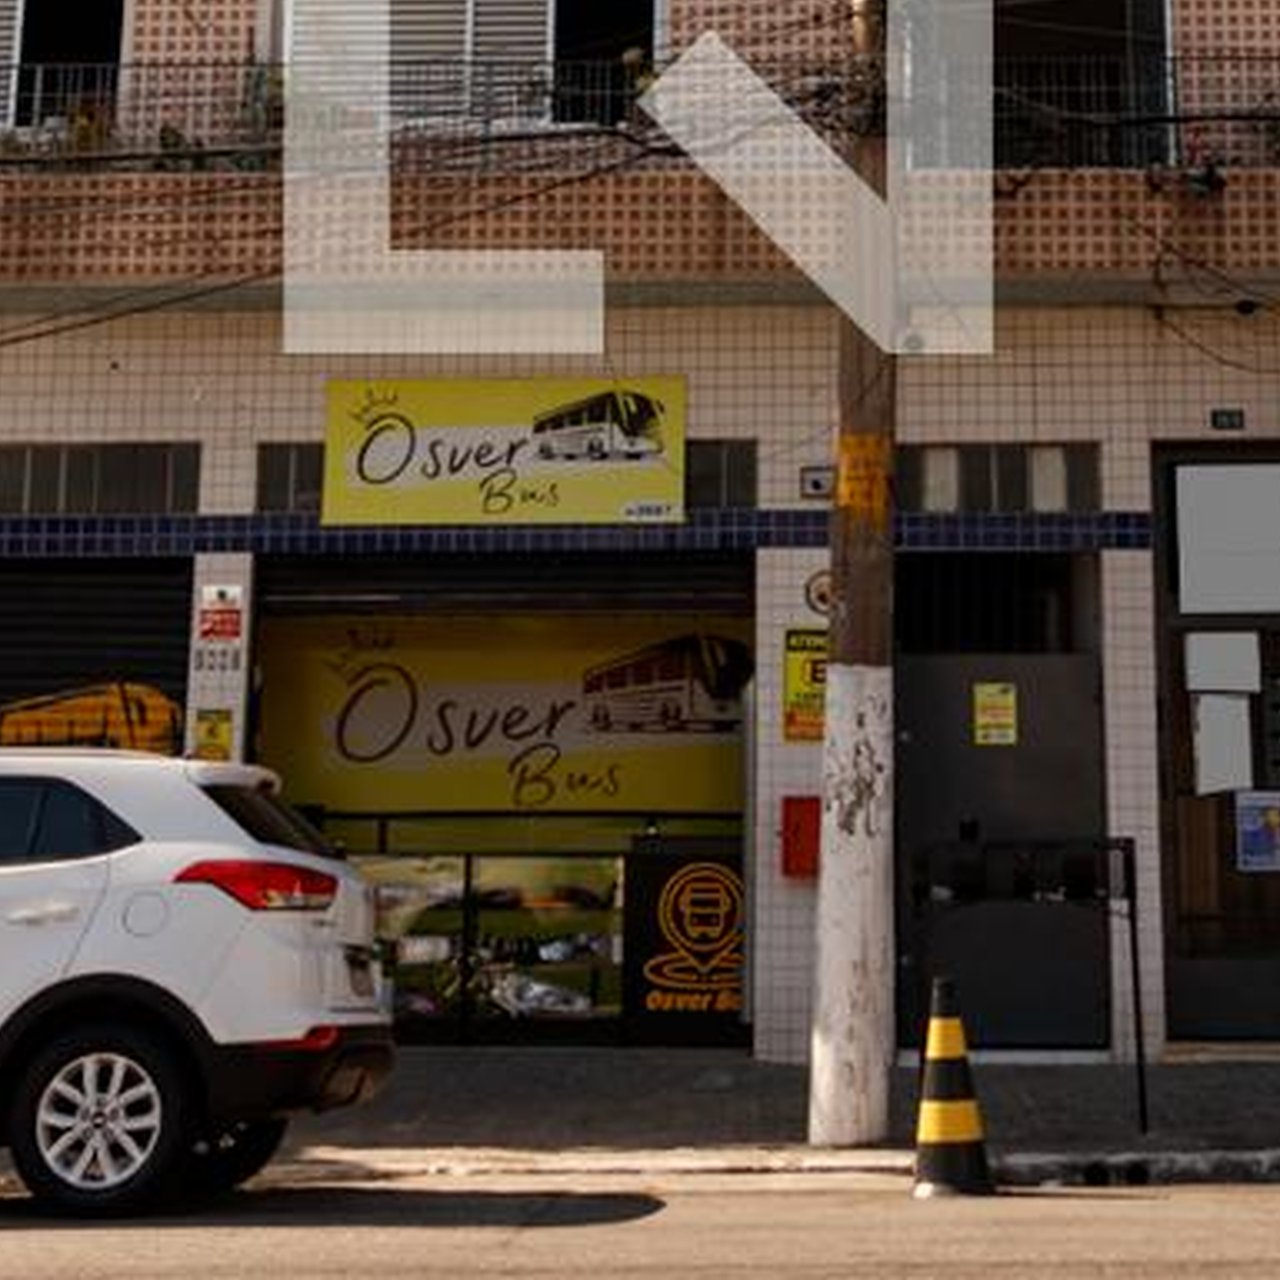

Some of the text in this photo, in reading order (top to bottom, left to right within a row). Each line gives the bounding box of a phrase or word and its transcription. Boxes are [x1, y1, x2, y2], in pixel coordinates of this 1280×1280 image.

[356, 411, 532, 484] Osver
[478, 470, 560, 514] Bus
[335, 662, 578, 763] Osver
[508, 743, 621, 808] Bus
